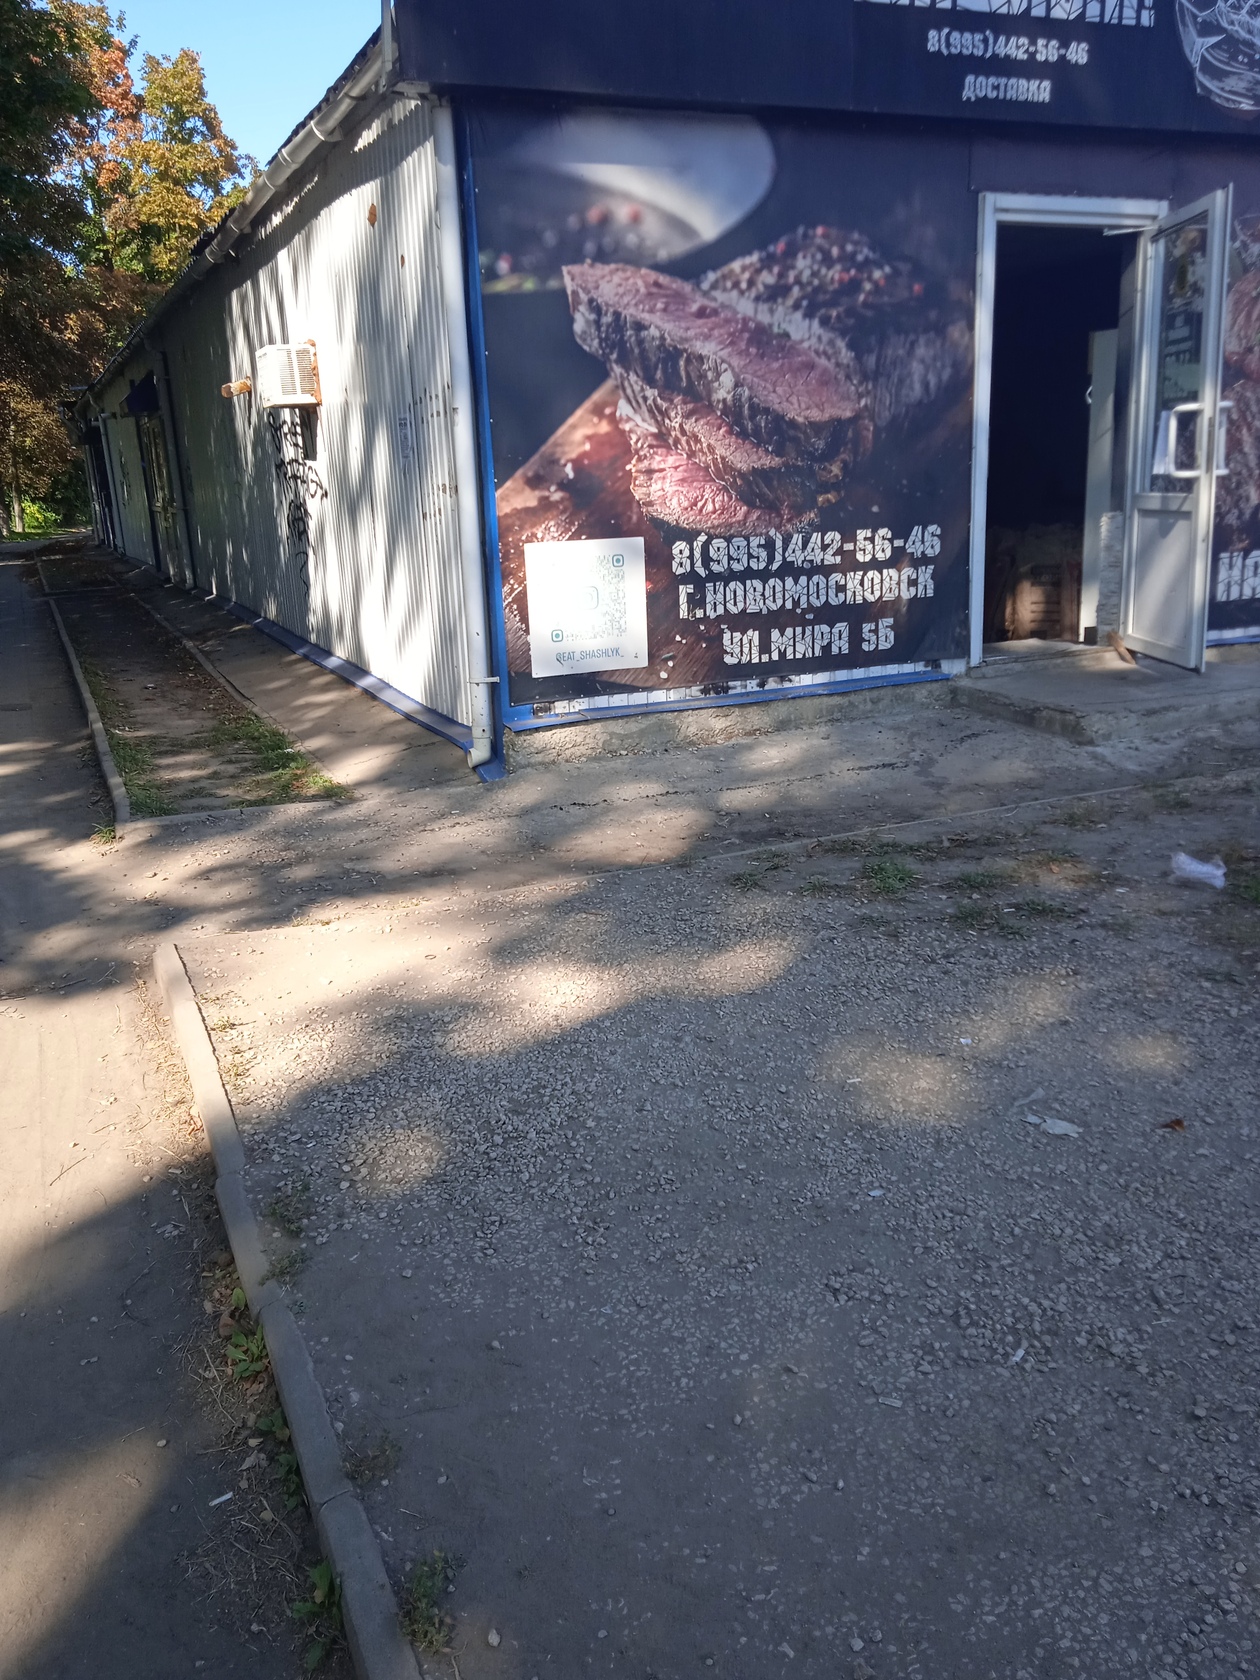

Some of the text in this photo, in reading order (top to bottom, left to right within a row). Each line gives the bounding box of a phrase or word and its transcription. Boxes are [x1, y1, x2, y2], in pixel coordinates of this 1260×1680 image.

[927, 27, 1089, 66] 8(995)442-56-46
[962, 74, 1051, 103] ДОСТАВКА
[671, 523, 942, 578] 8(995)442-56-46
[555, 646, 625, 663] @EAT_SHASHLYK_
